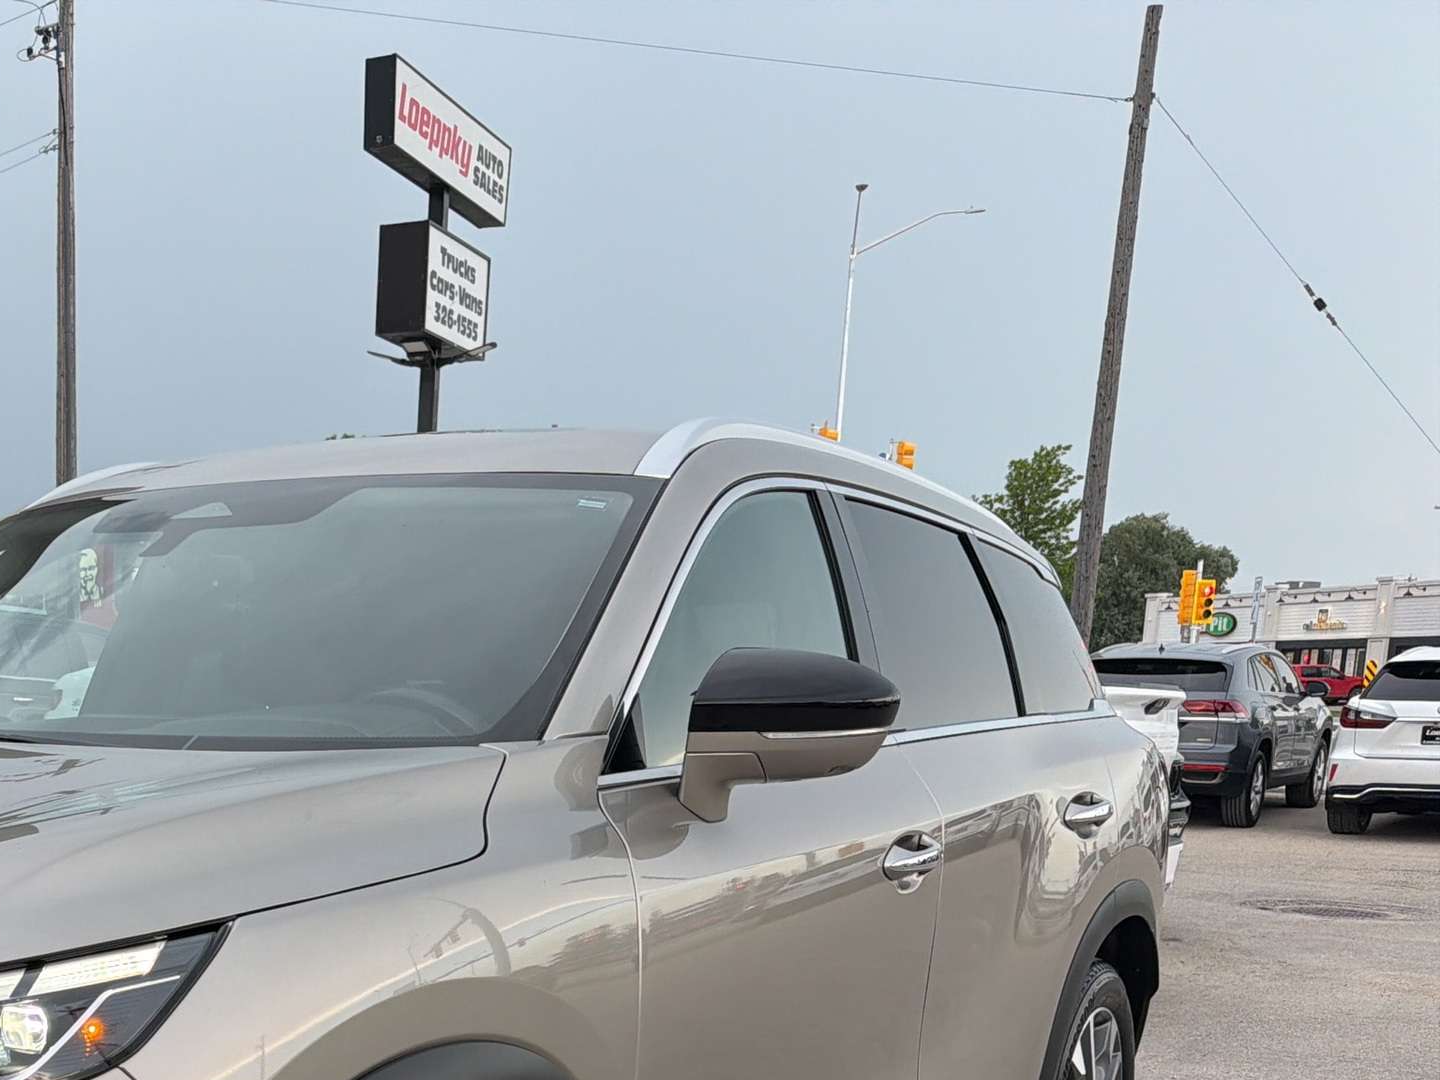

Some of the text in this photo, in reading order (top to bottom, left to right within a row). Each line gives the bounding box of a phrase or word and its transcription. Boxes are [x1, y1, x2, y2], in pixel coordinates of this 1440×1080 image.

[398, 82, 473, 178] Loeppky
[476, 143, 504, 180] AUTO
[472, 165, 504, 205] SALES
[440, 245, 476, 285] Trucks
